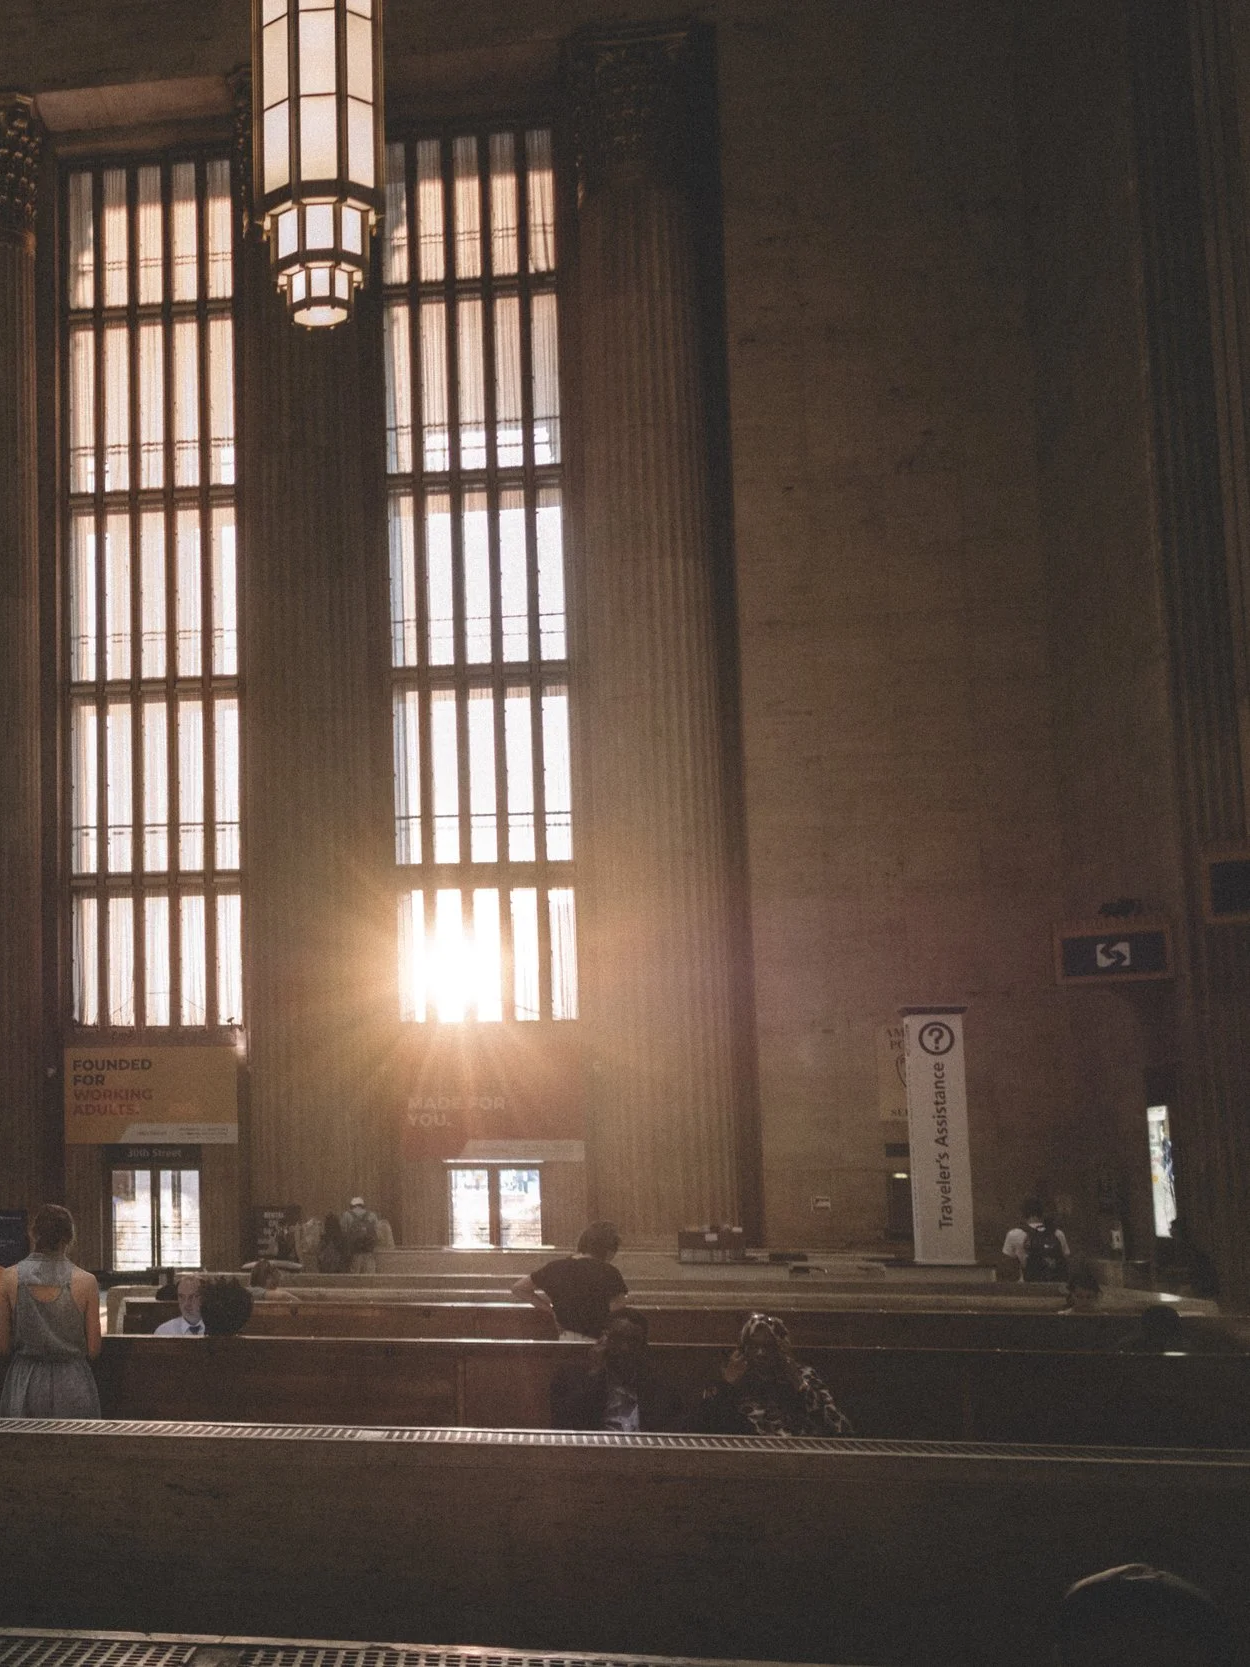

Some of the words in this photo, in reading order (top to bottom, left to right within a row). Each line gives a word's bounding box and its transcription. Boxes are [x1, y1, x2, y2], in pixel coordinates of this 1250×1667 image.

[72, 1058, 152, 1072] FOUNDED
[72, 1074, 105, 1087] FOR
[72, 1088, 153, 1101] WORKING
[72, 1103, 140, 1117] ADULTS.
[932, 1062, 949, 1147] Assistance
[406, 1112, 452, 1127] YOU.
[152, 1147, 182, 1158] Street
[935, 1150, 954, 1230] Traveler's
